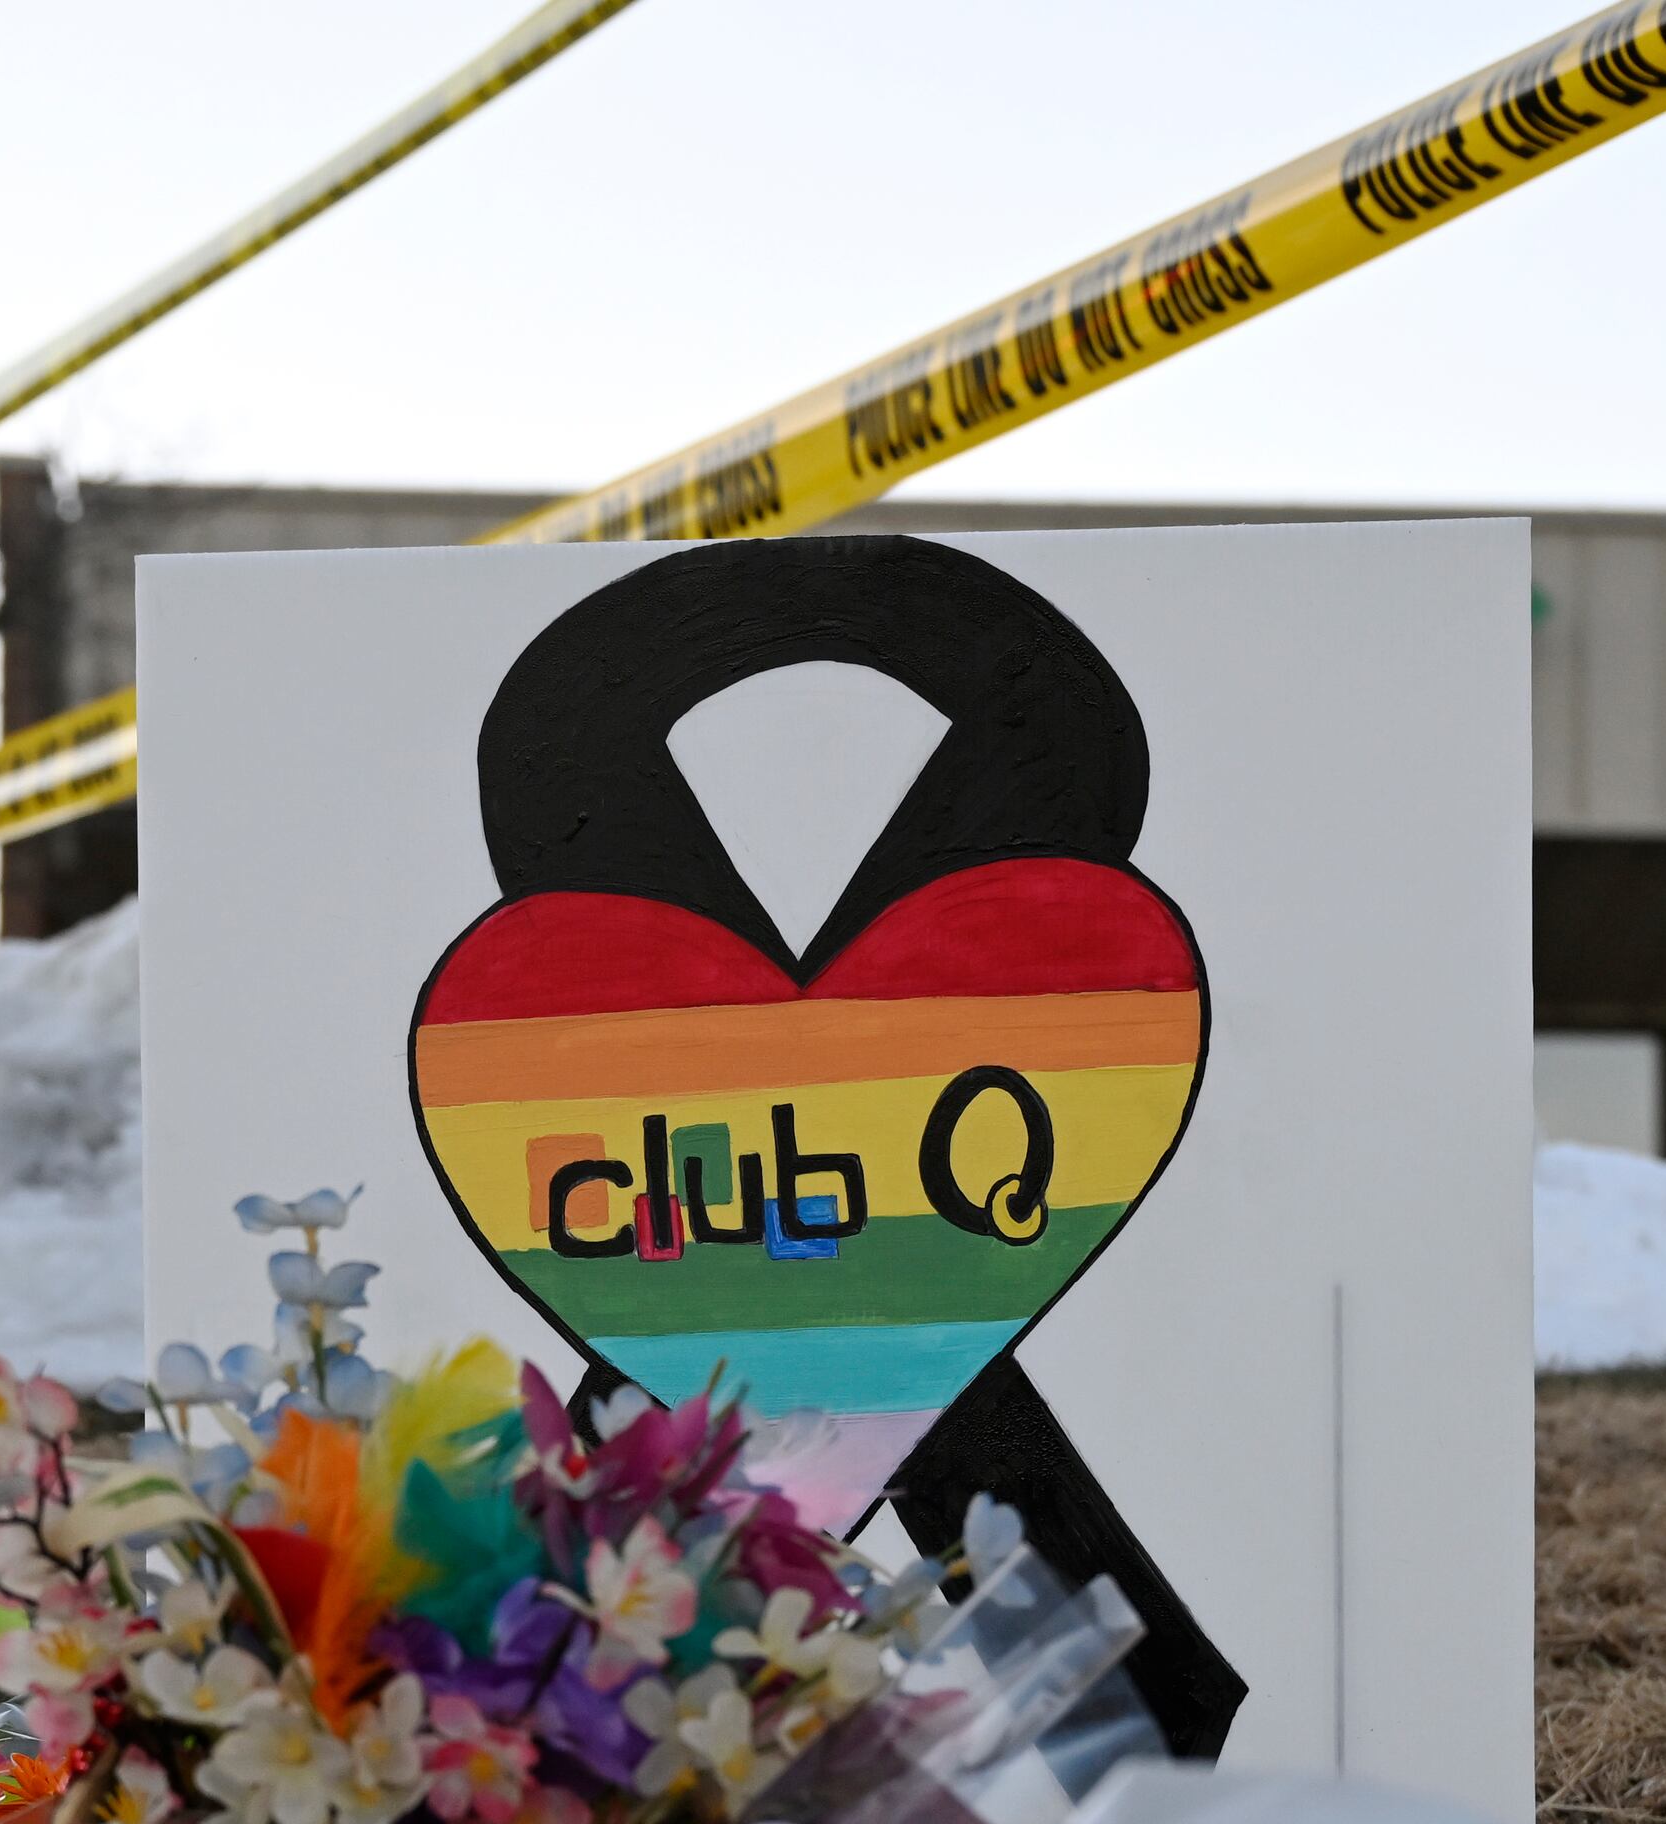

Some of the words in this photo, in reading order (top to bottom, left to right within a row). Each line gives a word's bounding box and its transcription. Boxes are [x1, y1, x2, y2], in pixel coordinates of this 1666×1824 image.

[1340, 82, 1503, 236] POLICE
[1480, 36, 1606, 161] LINE
[843, 345, 946, 478] POLICE
[945, 310, 1017, 430] LINE
[1015, 286, 1069, 397] DO
[1067, 248, 1145, 372] NOT
[1140, 193, 1274, 336] CROSS
[548, 1103, 868, 1260] club
[919, 1065, 1054, 1246] Q
